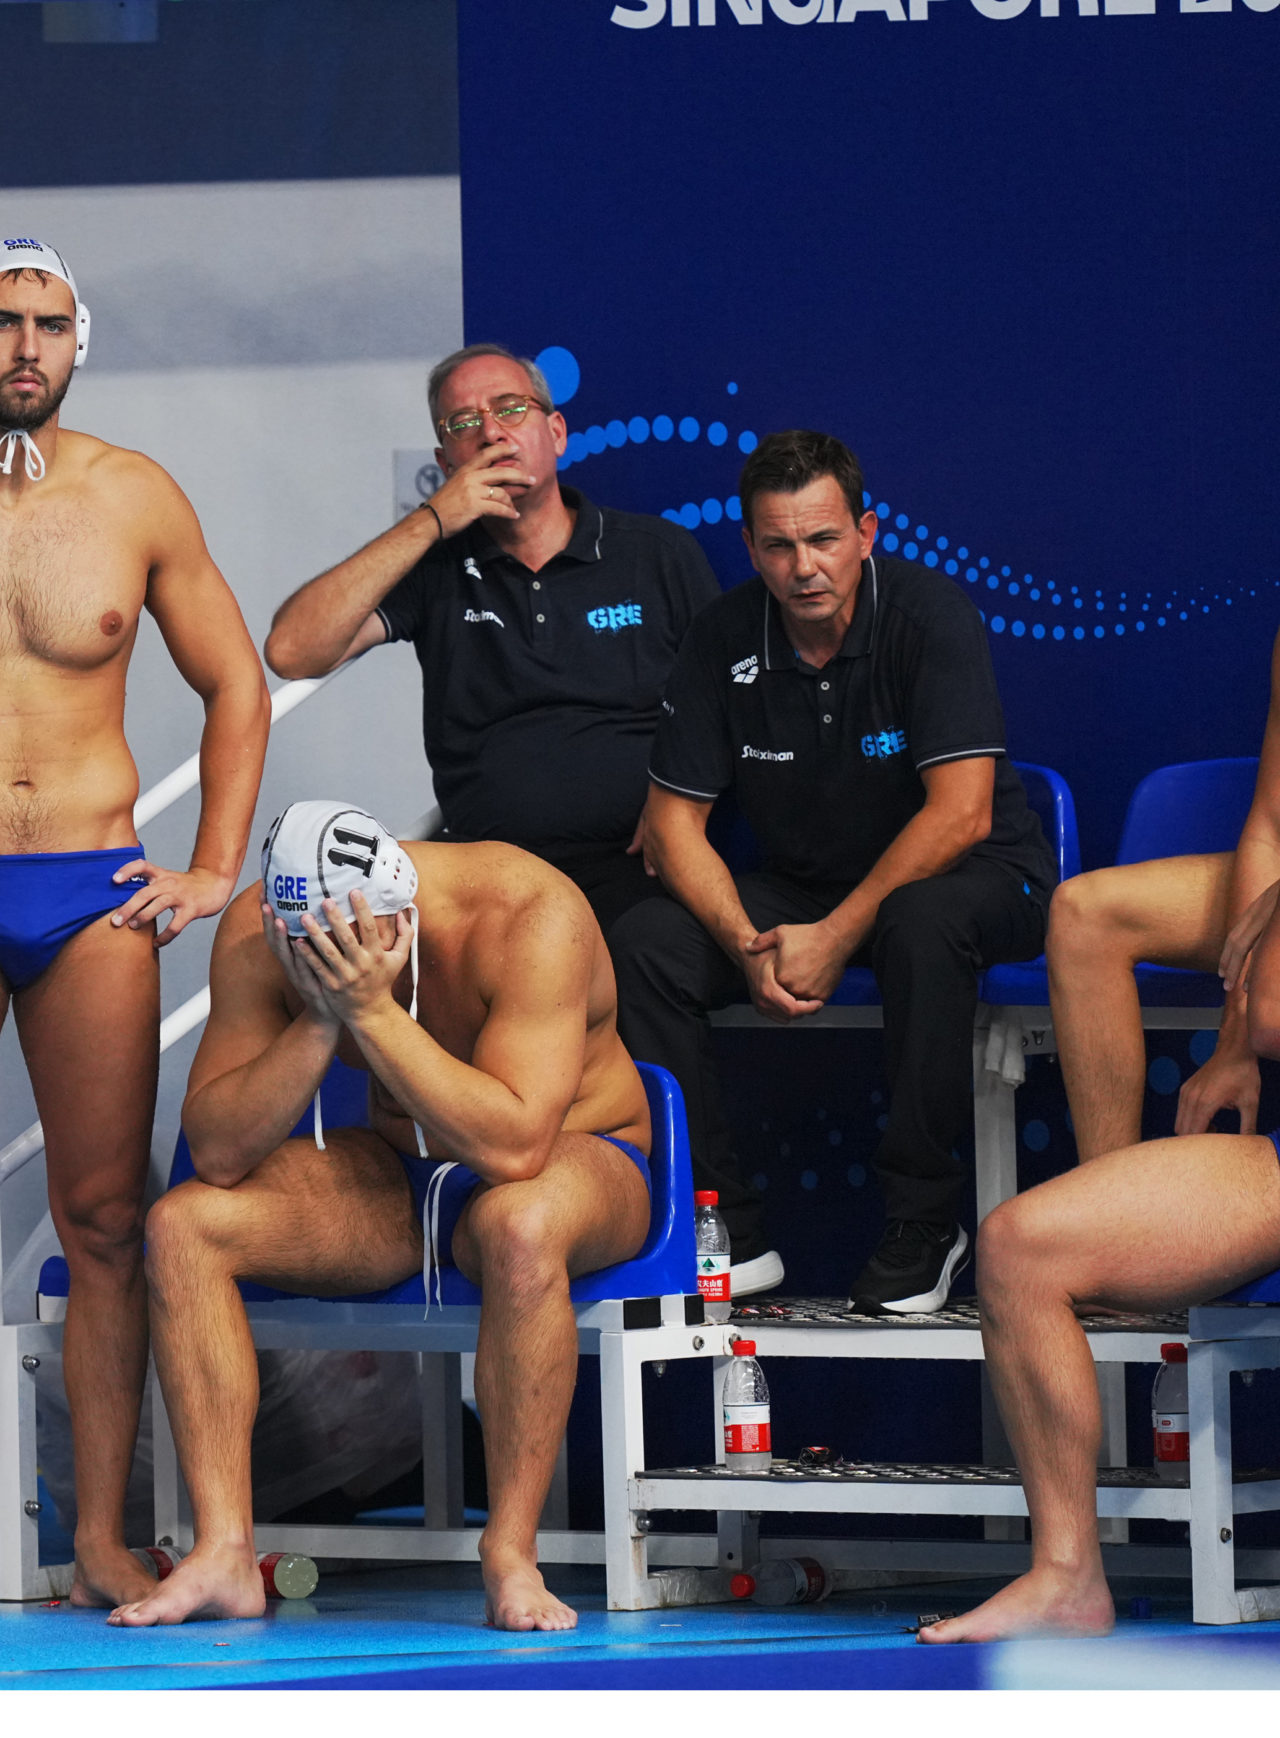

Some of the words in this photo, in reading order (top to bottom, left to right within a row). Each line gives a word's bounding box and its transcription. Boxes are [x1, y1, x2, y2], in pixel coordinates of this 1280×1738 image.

[7, 244, 43, 252] arena
[586, 602, 642, 630] GRE
[730, 654, 758, 675] arena
[860, 729, 908, 759] GRE
[327, 826, 380, 878] 11
[274, 874, 307, 900] GRE
[277, 900, 308, 912] arena
